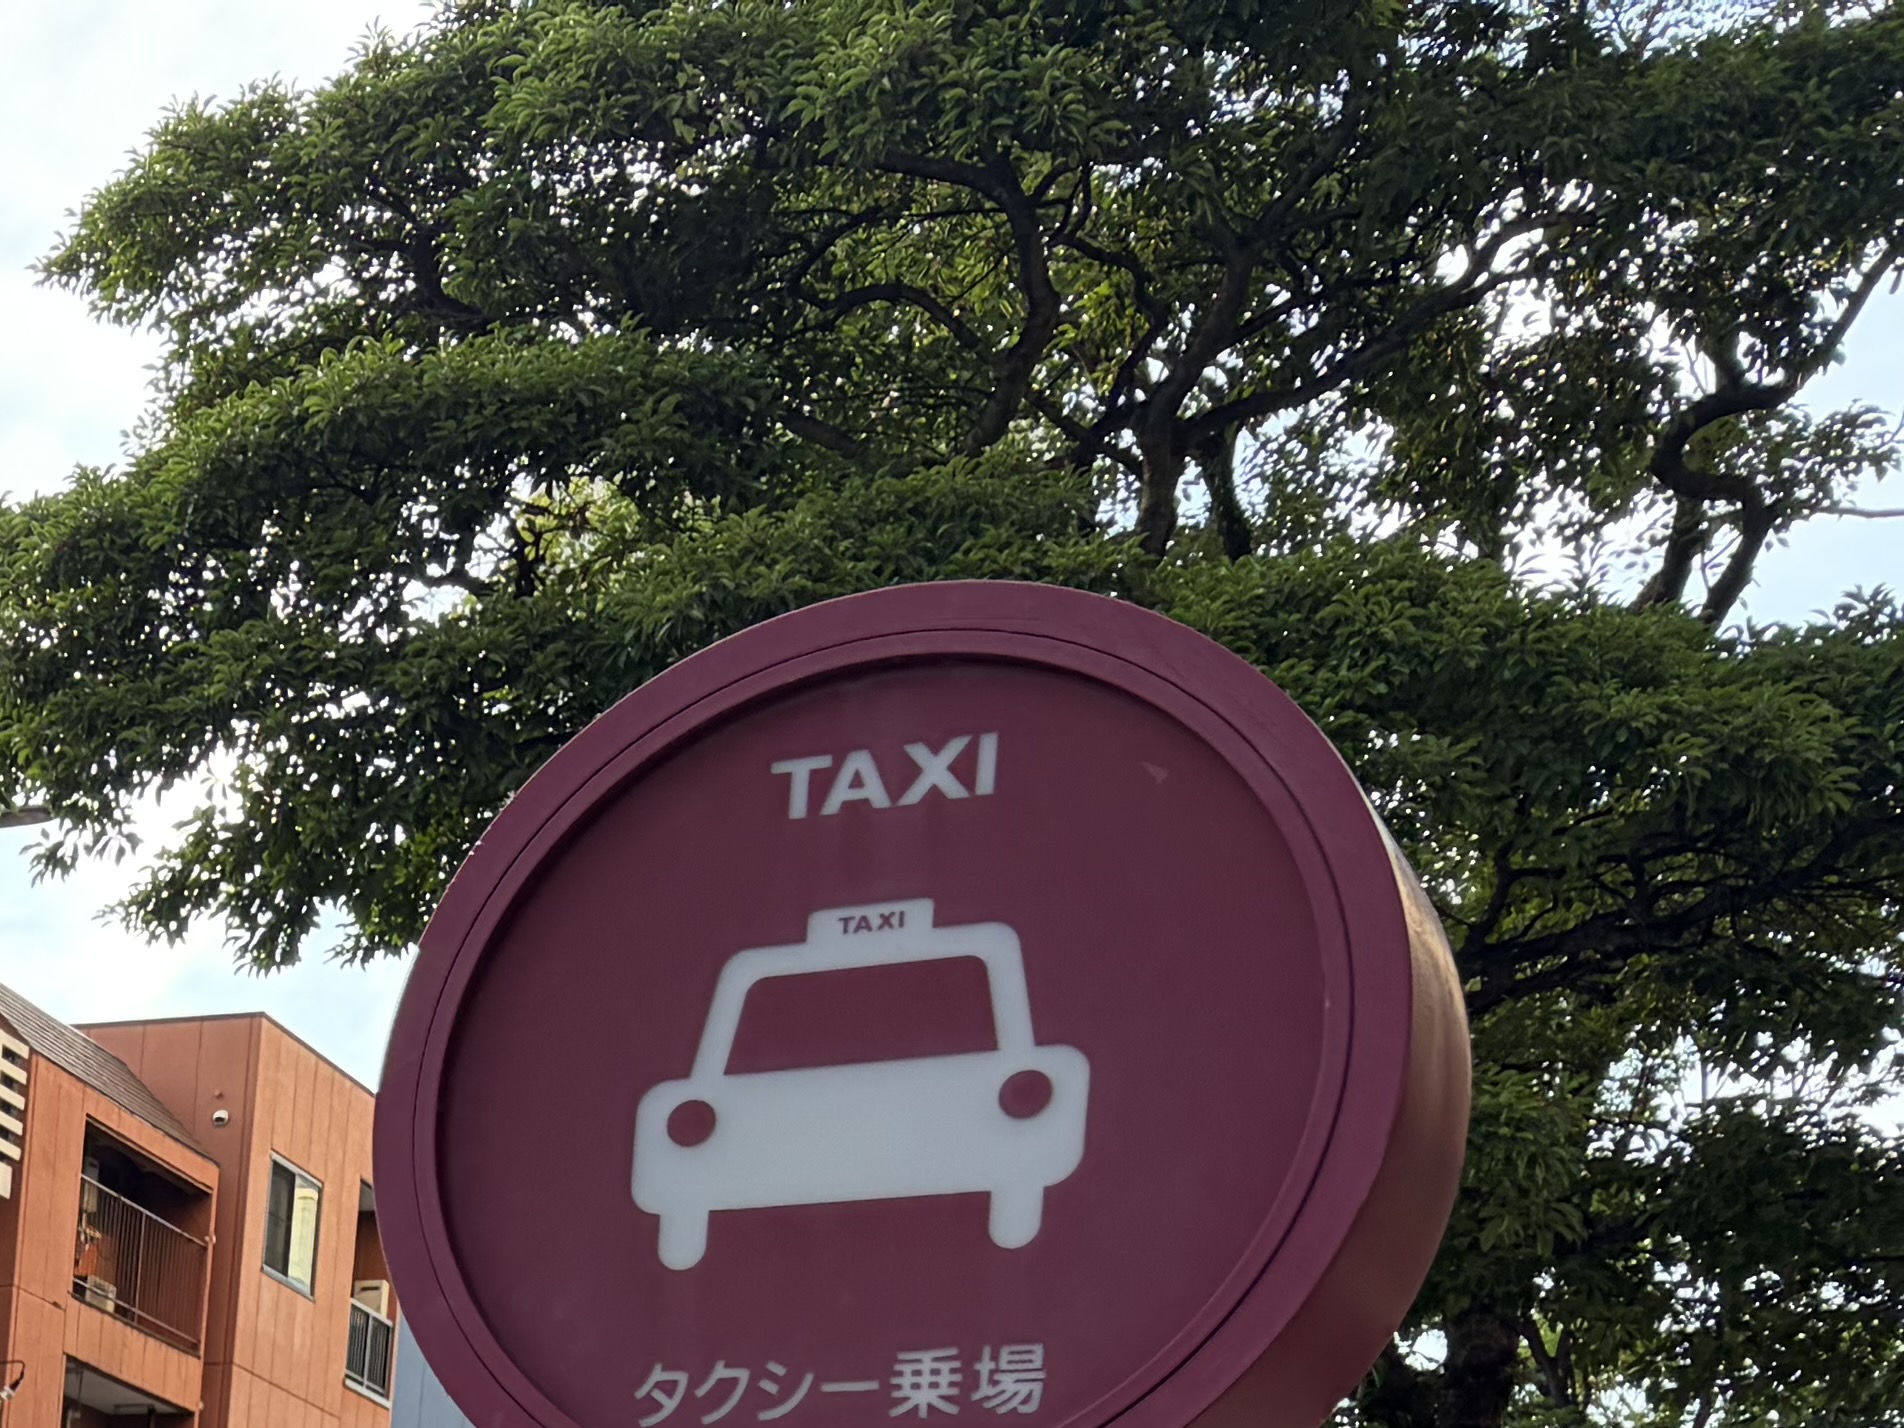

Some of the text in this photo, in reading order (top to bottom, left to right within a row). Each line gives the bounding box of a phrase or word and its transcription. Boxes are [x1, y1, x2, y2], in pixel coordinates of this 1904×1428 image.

[771, 731, 999, 820] TAXI
[837, 909, 907, 937] TAXI
[632, 1343, 1045, 1428] タクシー乗場
